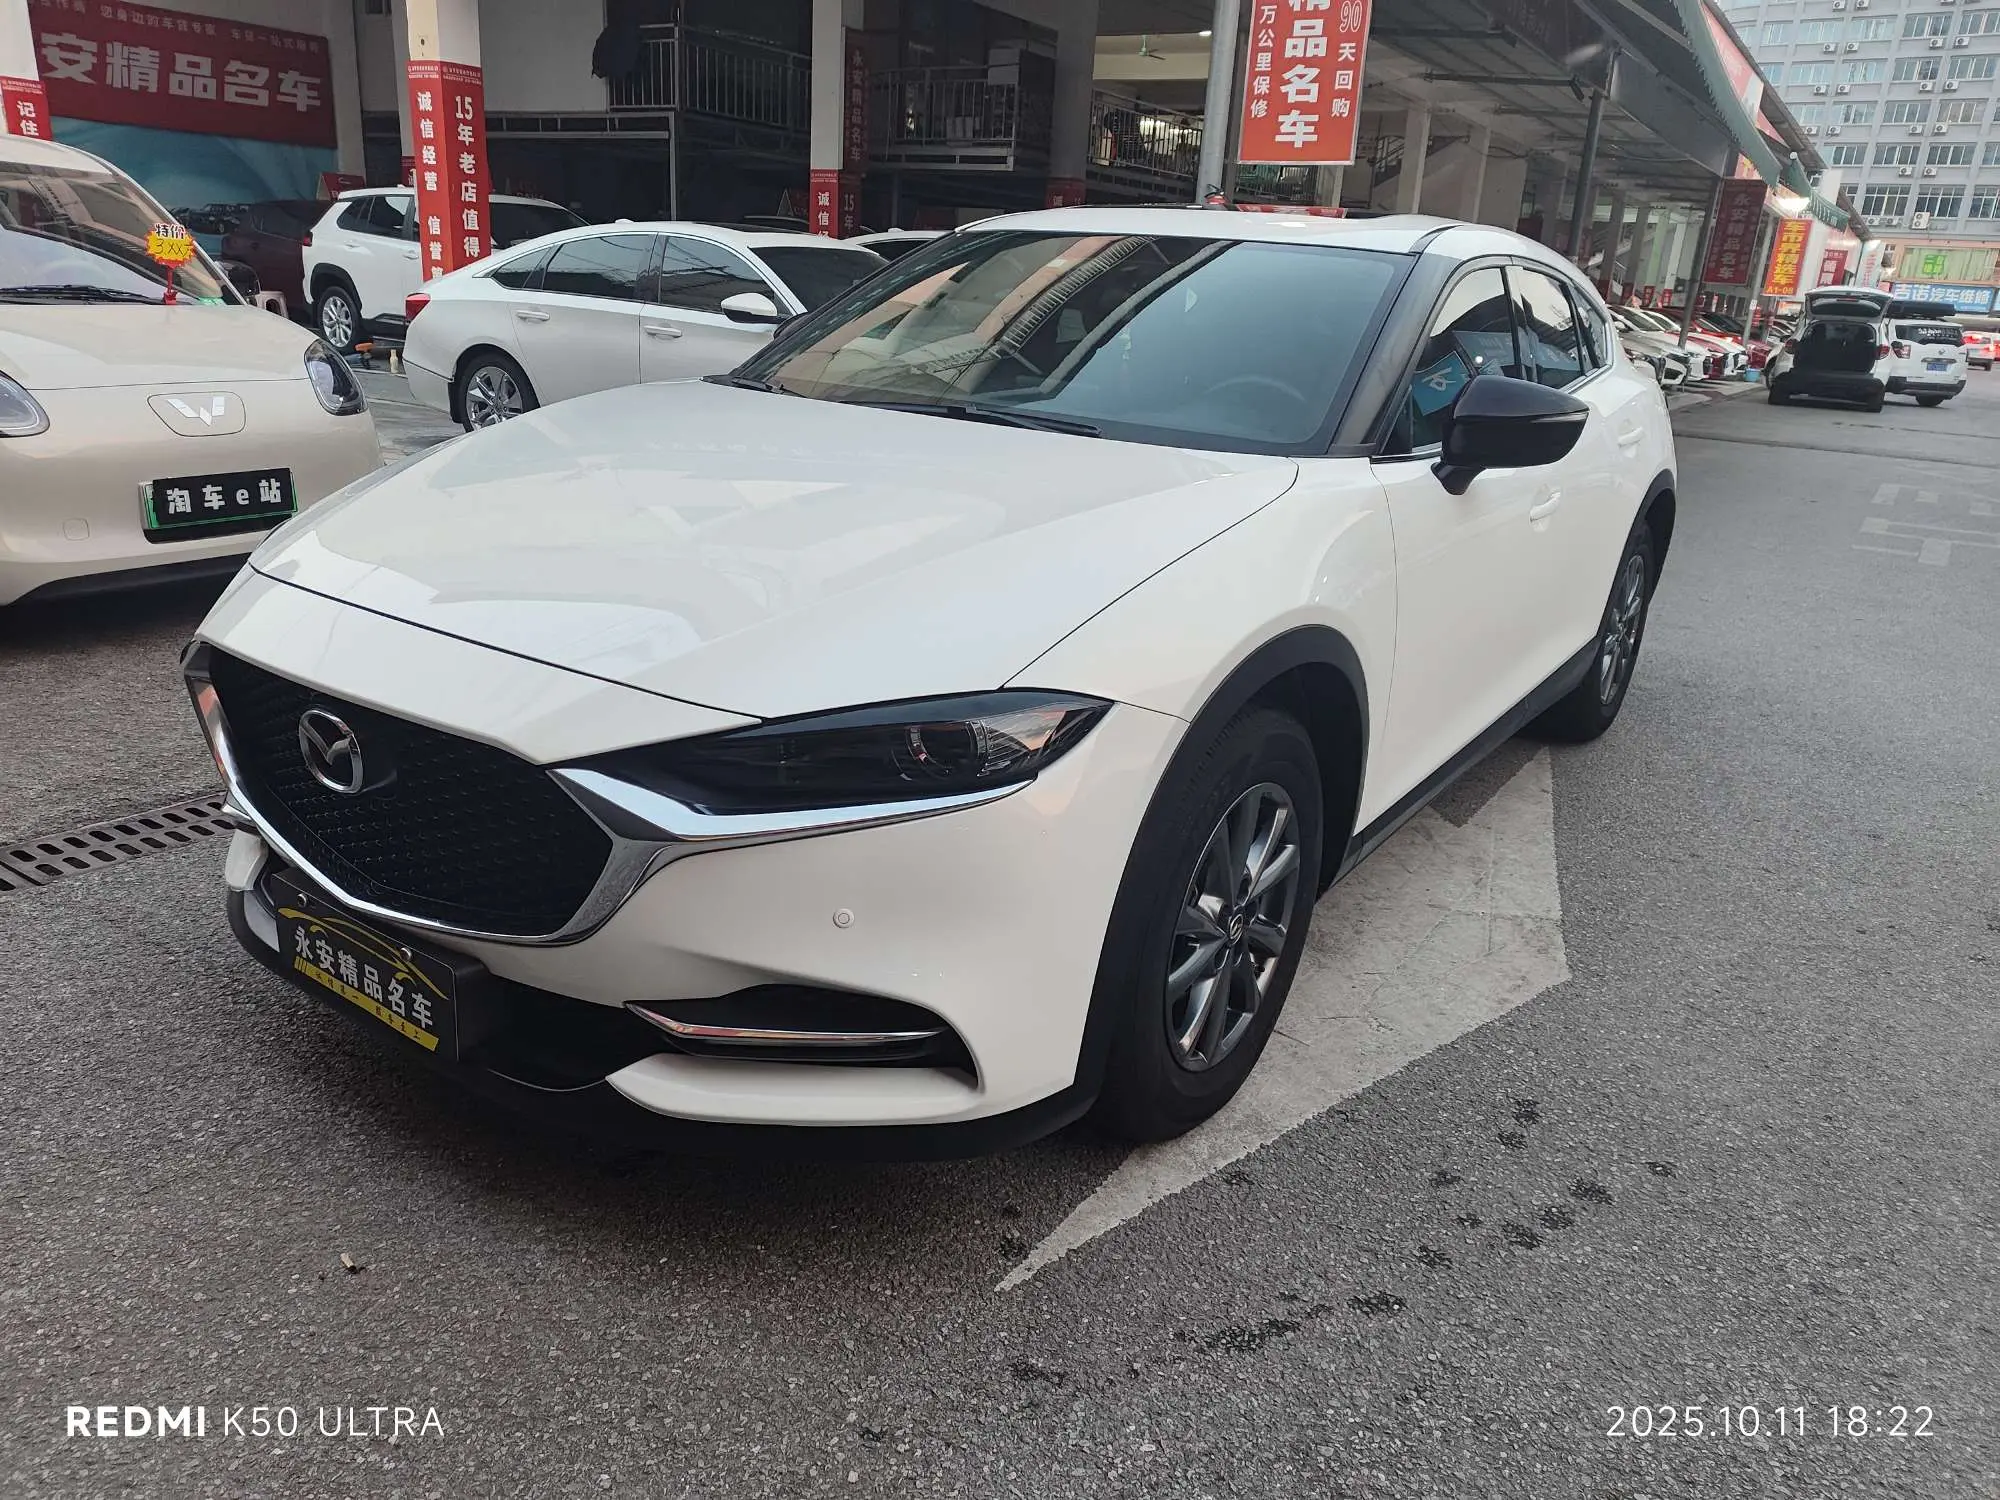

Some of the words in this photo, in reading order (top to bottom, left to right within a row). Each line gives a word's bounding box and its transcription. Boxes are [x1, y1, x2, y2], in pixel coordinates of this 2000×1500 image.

[40, 33, 322, 112] 安精品名车
[1250, 5, 1278, 118] 万公里保修
[1331, 0, 1363, 118] 90天回购
[16, 100, 40, 136] 记住
[416, 91, 438, 192] 诚信经营
[454, 95, 481, 258] 15年老店值得
[154, 223, 186, 240] 特价
[1894, 284, 1991, 305] 吉诺汽车维修
[166, 478, 282, 515] 淘车e站
[294, 926, 433, 1029] 永安精品名车
